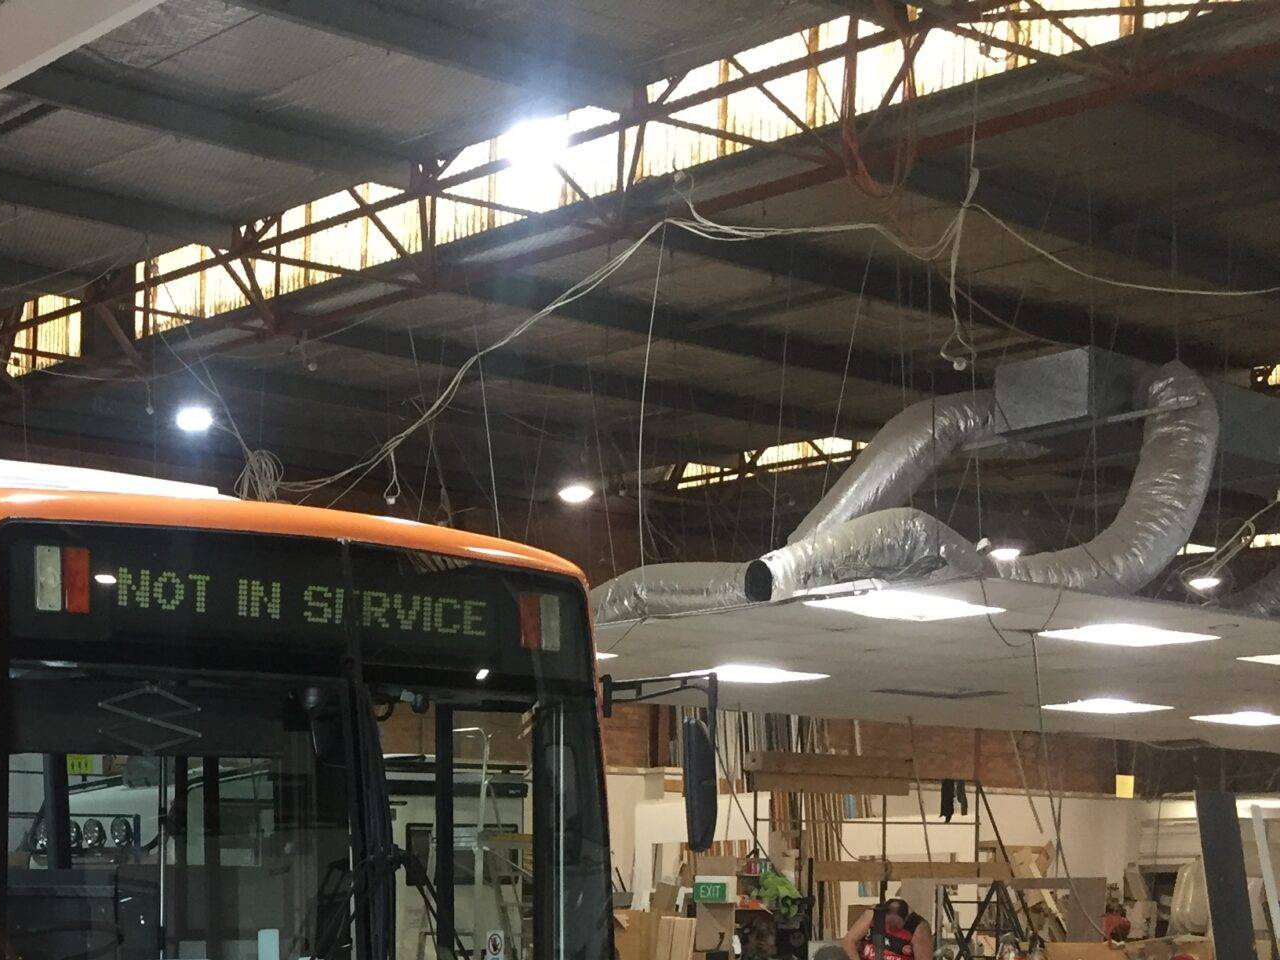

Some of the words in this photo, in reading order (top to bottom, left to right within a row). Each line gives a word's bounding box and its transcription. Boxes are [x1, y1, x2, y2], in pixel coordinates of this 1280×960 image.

[118, 567, 211, 613] NOT
[238, 578, 281, 620] IN
[700, 885, 721, 898] EXIT
